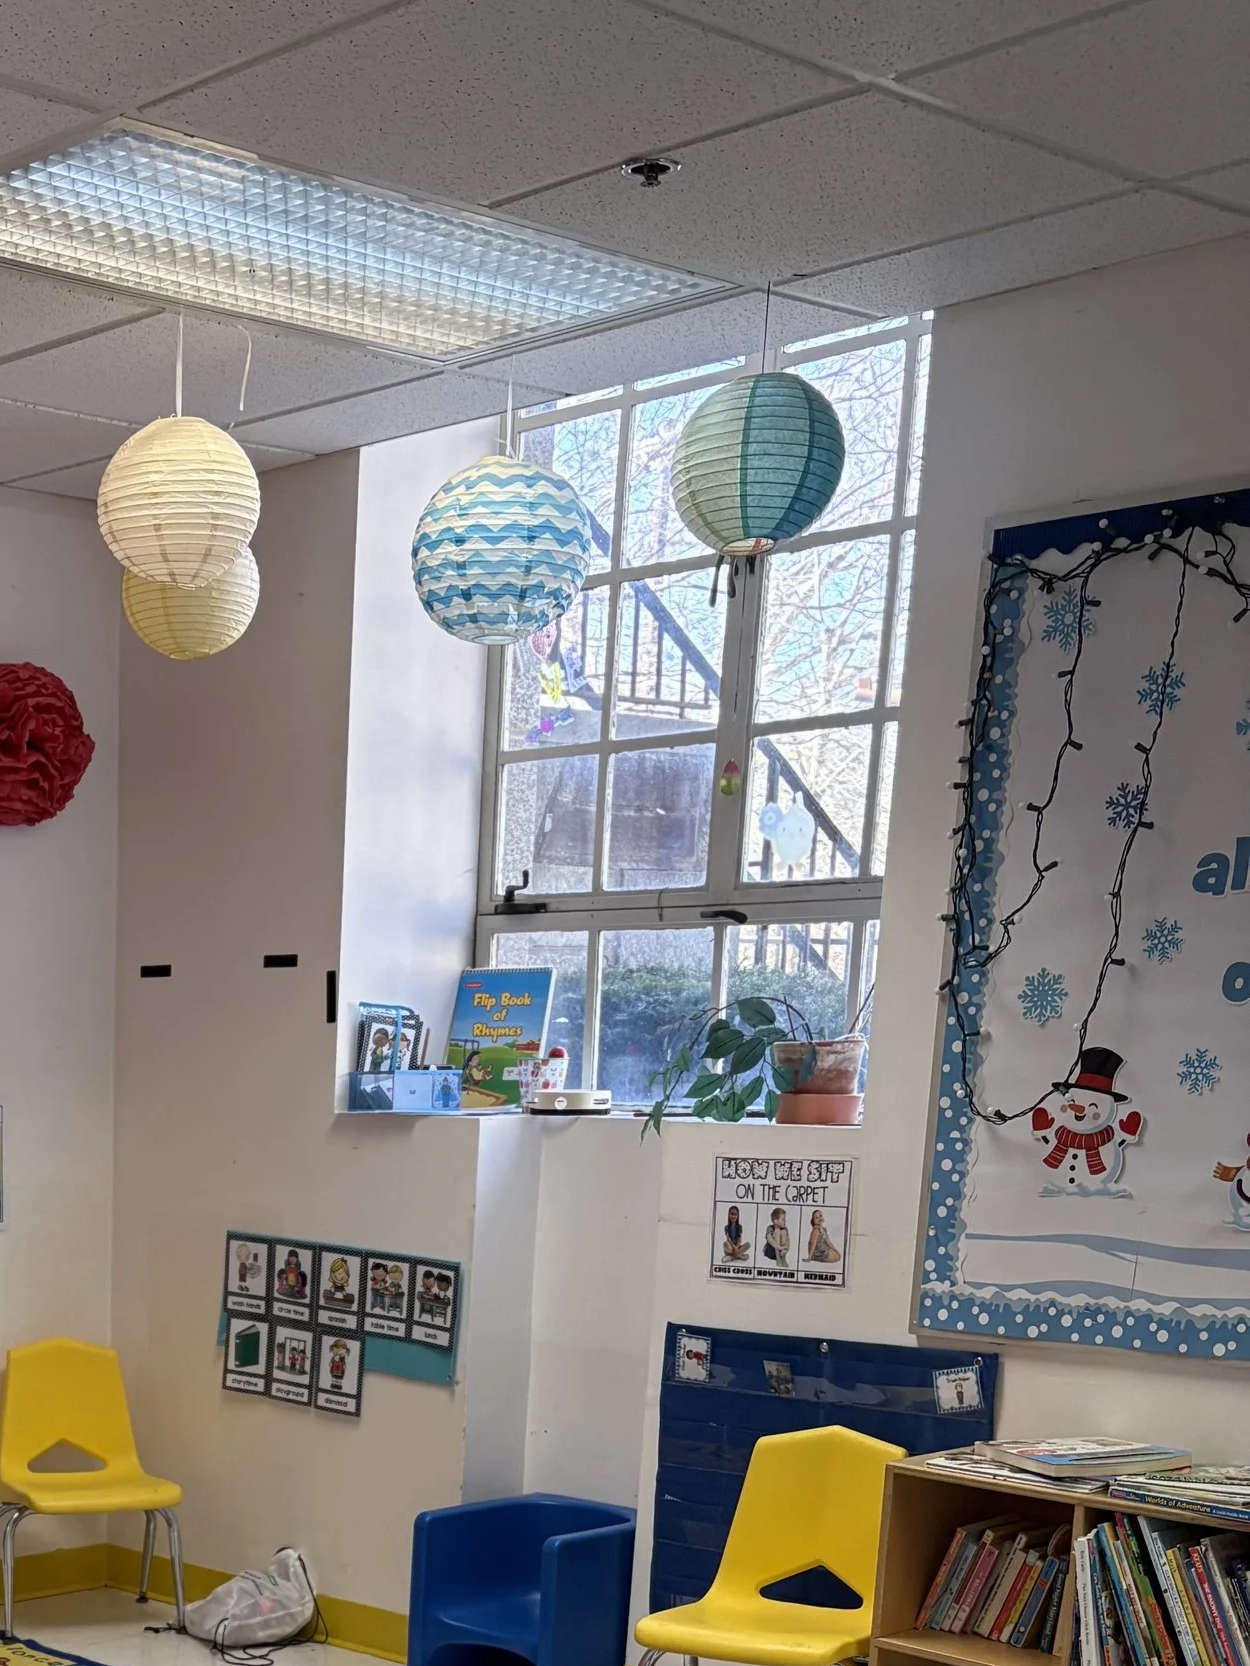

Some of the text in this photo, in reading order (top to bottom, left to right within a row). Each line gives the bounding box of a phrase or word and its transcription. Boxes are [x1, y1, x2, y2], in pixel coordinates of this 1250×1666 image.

[473, 992, 532, 1011] Flip Book
[493, 1008, 508, 1021] of
[472, 1023, 523, 1043] Rhymes
[721, 1158, 845, 1184] HOW WE SIT
[735, 1183, 781, 1202] ON THE
[713, 1266, 753, 1275] CRISS CROSS
[756, 1269, 795, 1279] MOUNTAIN
[804, 1272, 836, 1282] MERMAID
[1144, 1495, 1211, 1513] Worlds of Adventure
